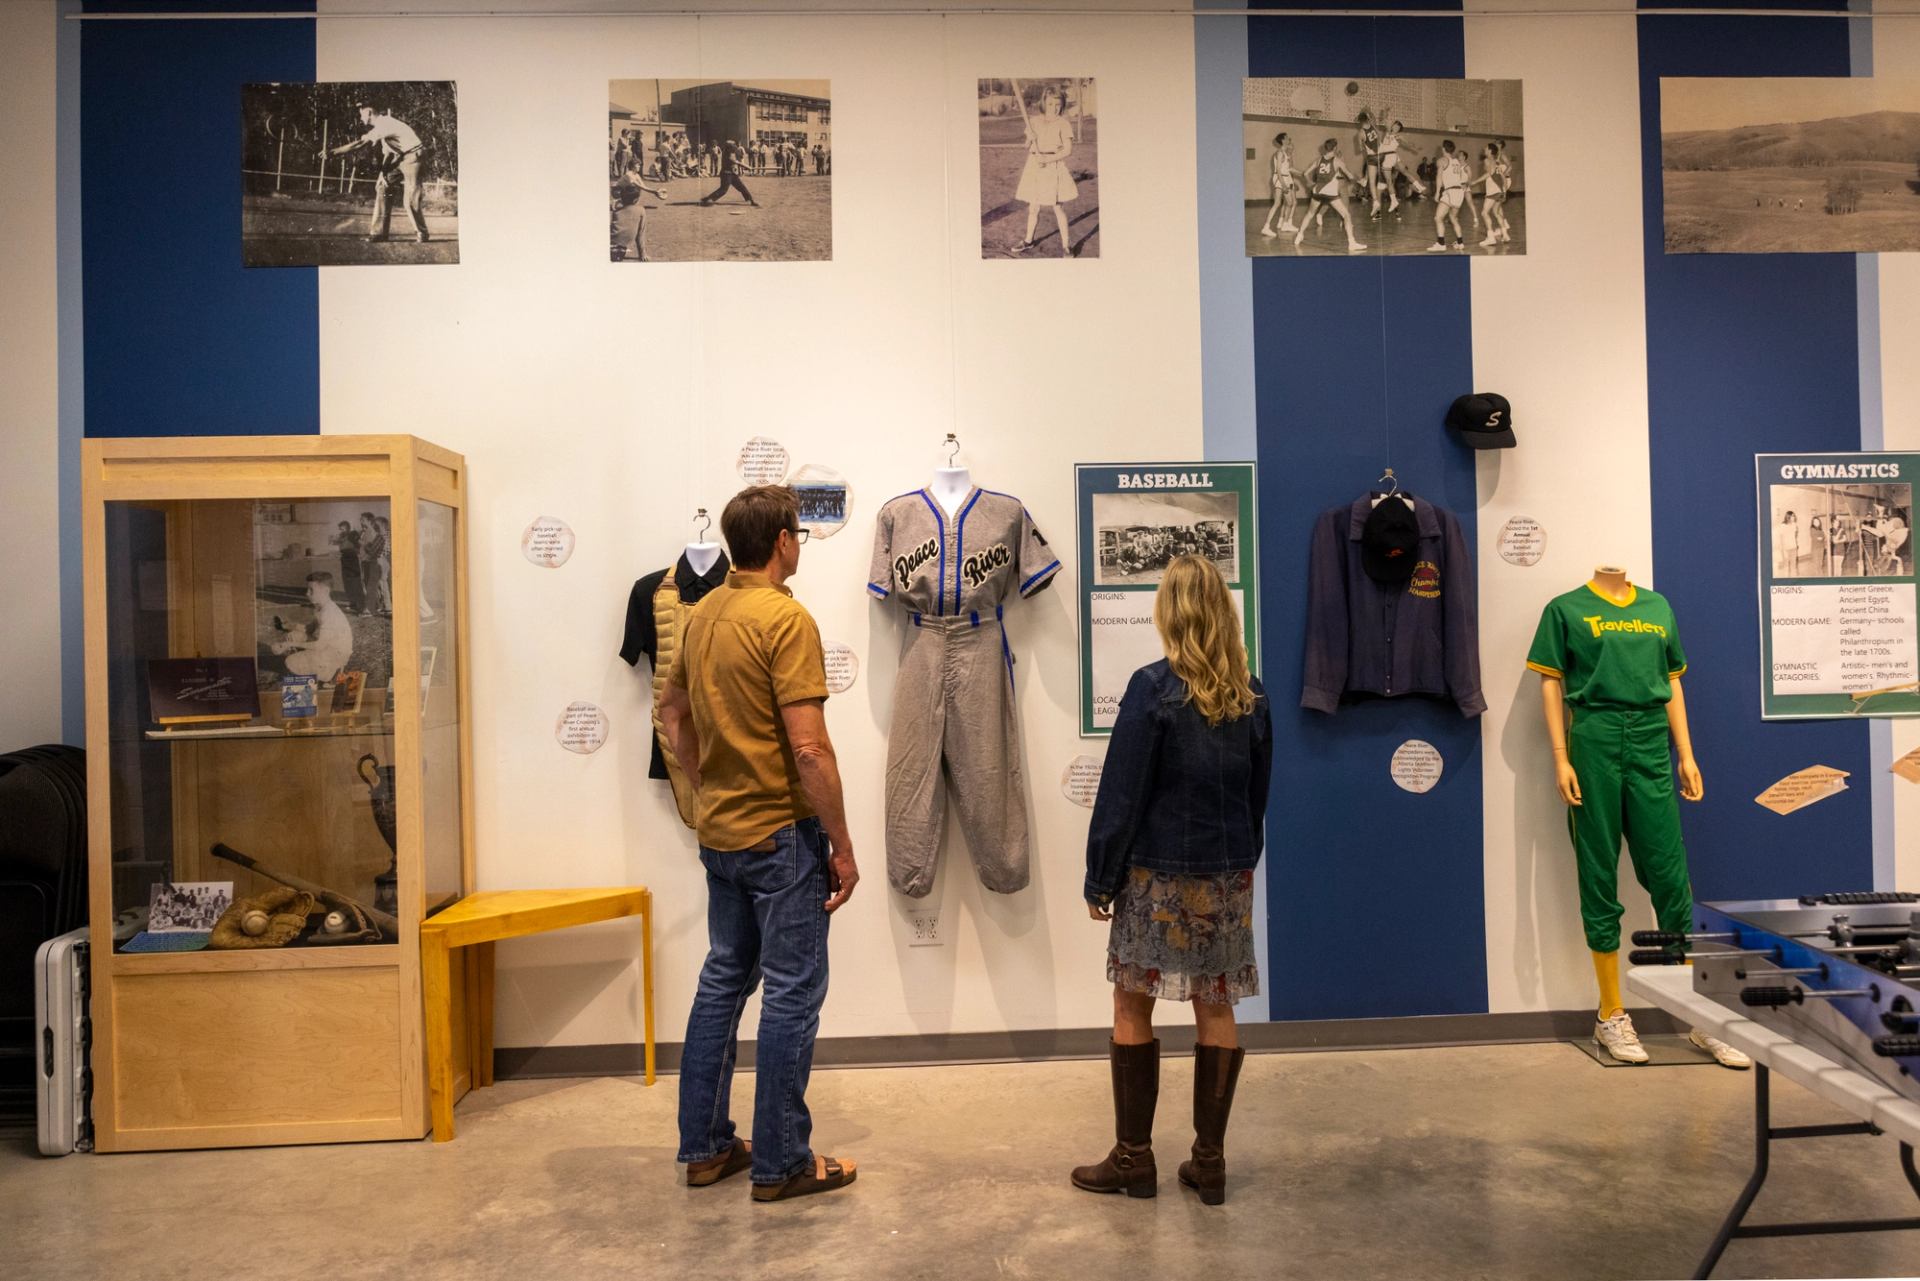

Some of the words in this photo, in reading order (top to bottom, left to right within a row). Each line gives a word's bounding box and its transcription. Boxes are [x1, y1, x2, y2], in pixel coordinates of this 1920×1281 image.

[1320, 163, 1331, 174] 24
[1485, 411, 1502, 427] S
[1781, 463, 1900, 479] GYMNASTICS
[1118, 473, 1213, 488] BASEBALL
[893, 538, 940, 592] Peace
[963, 543, 1010, 589] River
[1092, 617, 1128, 625] MODERN
[1583, 615, 1666, 638] Travellers
[1774, 662, 1817, 670] GYMNASTIC
